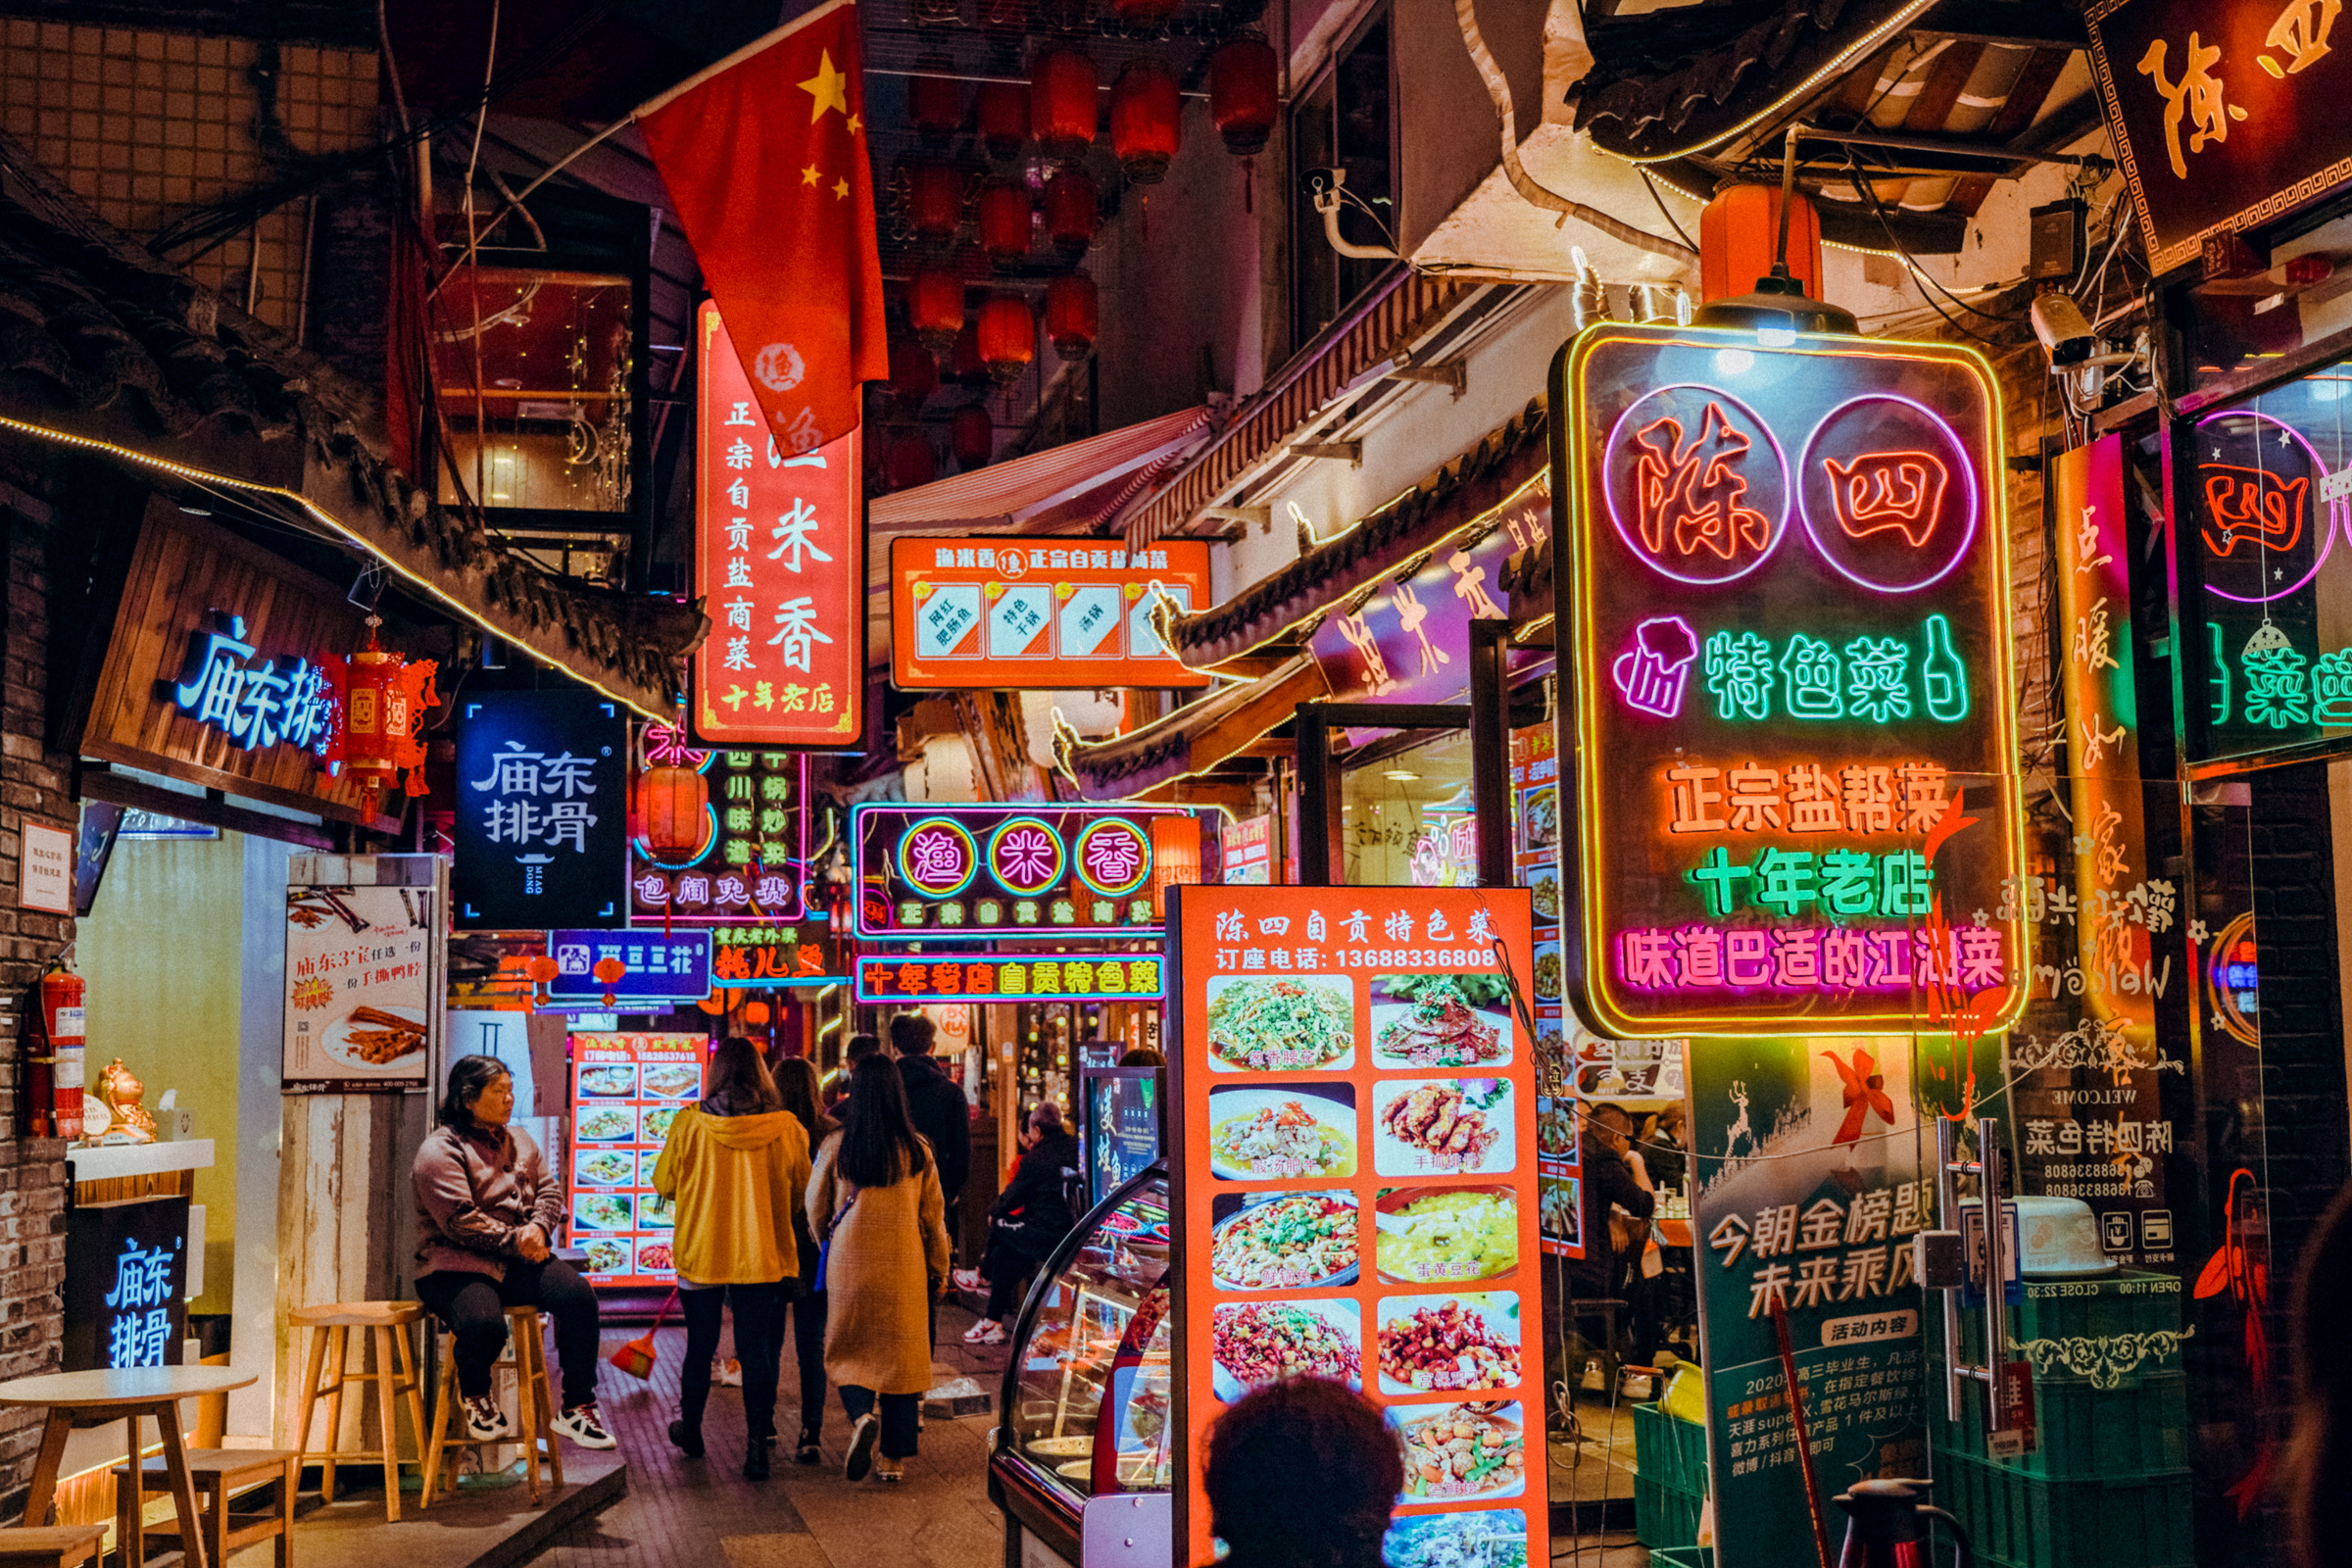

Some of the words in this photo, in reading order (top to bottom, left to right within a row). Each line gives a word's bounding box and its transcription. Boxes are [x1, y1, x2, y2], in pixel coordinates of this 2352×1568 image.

[722, 401, 758, 672] 正宗自贡盐商菜
[935, 548, 996, 568] 渔米香
[1029, 549, 1168, 569] 正宗自贡盐商菜
[928, 598, 955, 627] 网红
[936, 607, 972, 647] 肥肠鱼
[1003, 599, 1029, 625] 特色
[1016, 609, 1041, 637] 干锅
[1079, 603, 1104, 632] 汤锅
[1705, 631, 1911, 723] 特色菜
[720, 680, 834, 714] 十年老店
[470, 740, 598, 799] 庙东
[726, 752, 753, 864] 四川味道
[1665, 761, 1950, 834] 正宗盐帮菜
[483, 799, 598, 854] 排骨
[913, 830, 1140, 884] 渔米香
[525, 865, 534, 895] DONG
[634, 875, 790, 906] 包间免费
[1690, 846, 1935, 916] 十年老店
[1215, 907, 1499, 945] 陈四自贡特色菜
[1215, 948, 1327, 970] 订座电话:
[1336, 949, 1496, 967] 13688336808
[1623, 927, 2005, 989] 味道巴适的江湖菜
[1249, 1049, 1316, 1066] 葱香腰花
[1412, 1048, 1475, 1063] 干拌牛肉
[1251, 1158, 1318, 1174] 酸汤肥牛
[1413, 1154, 1479, 1170] 手抓排骨
[105, 1237, 174, 1309] 庙东
[1261, 1268, 1312, 1285] 鲜锅兔
[1416, 1261, 1482, 1278] 蛋黄豆花
[109, 1307, 172, 1369] 排骨
[1831, 1315, 1908, 1342] 活动内容
